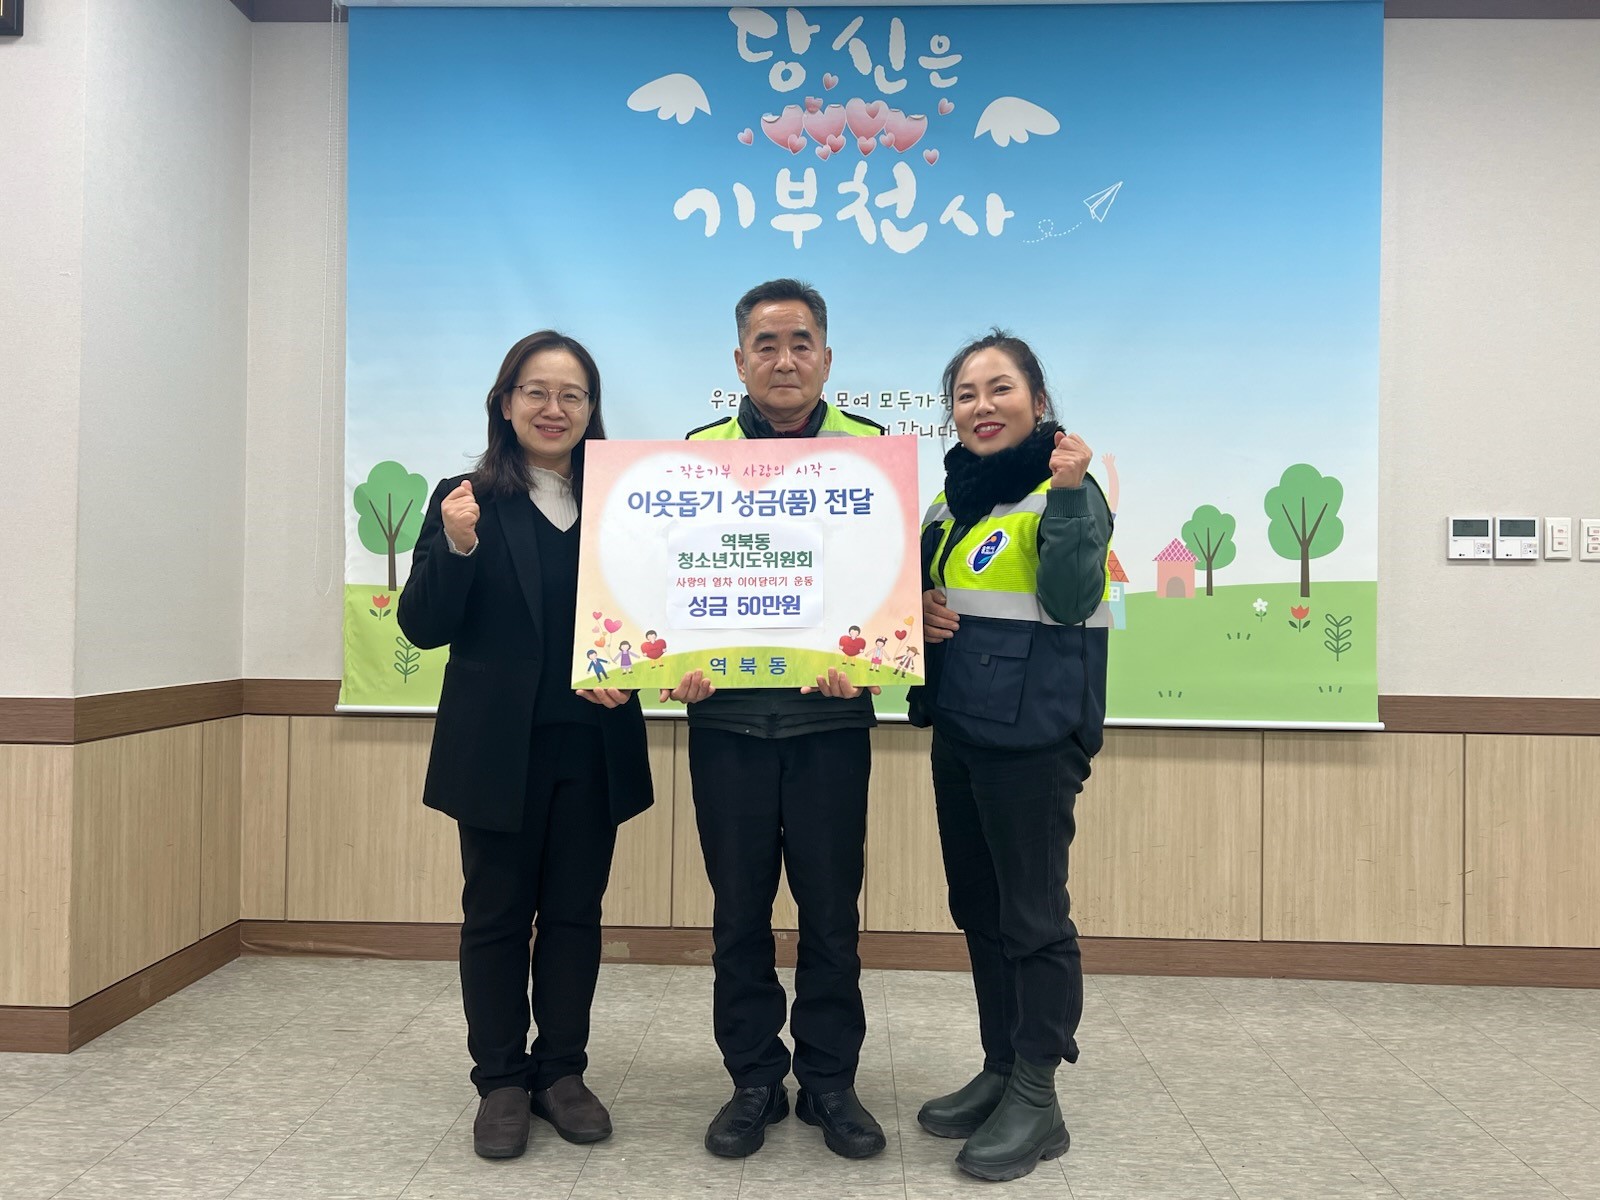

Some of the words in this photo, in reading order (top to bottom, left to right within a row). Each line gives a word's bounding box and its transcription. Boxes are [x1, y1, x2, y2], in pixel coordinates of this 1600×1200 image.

[728, 7, 963, 94] 당신은
[673, 160, 1015, 253] 기부천사
[836, 392, 869, 408] 모여
[680, 464, 732, 479] 작은기부
[743, 463, 785, 478] 사랑의
[796, 462, 823, 477] 시작
[627, 489, 723, 518] 이웃돕기
[731, 488, 817, 517] 성금(품)
[824, 487, 874, 515] 전달
[720, 533, 771, 550] 역북동
[677, 550, 813, 569] 청소년지도위원회
[676, 577, 707, 588] 사랑의
[712, 576, 733, 588] 열차
[737, 576, 788, 588] 이어달리기
[793, 575, 814, 587] 운동
[688, 596, 728, 617] 성금
[737, 595, 801, 616] 50만원
